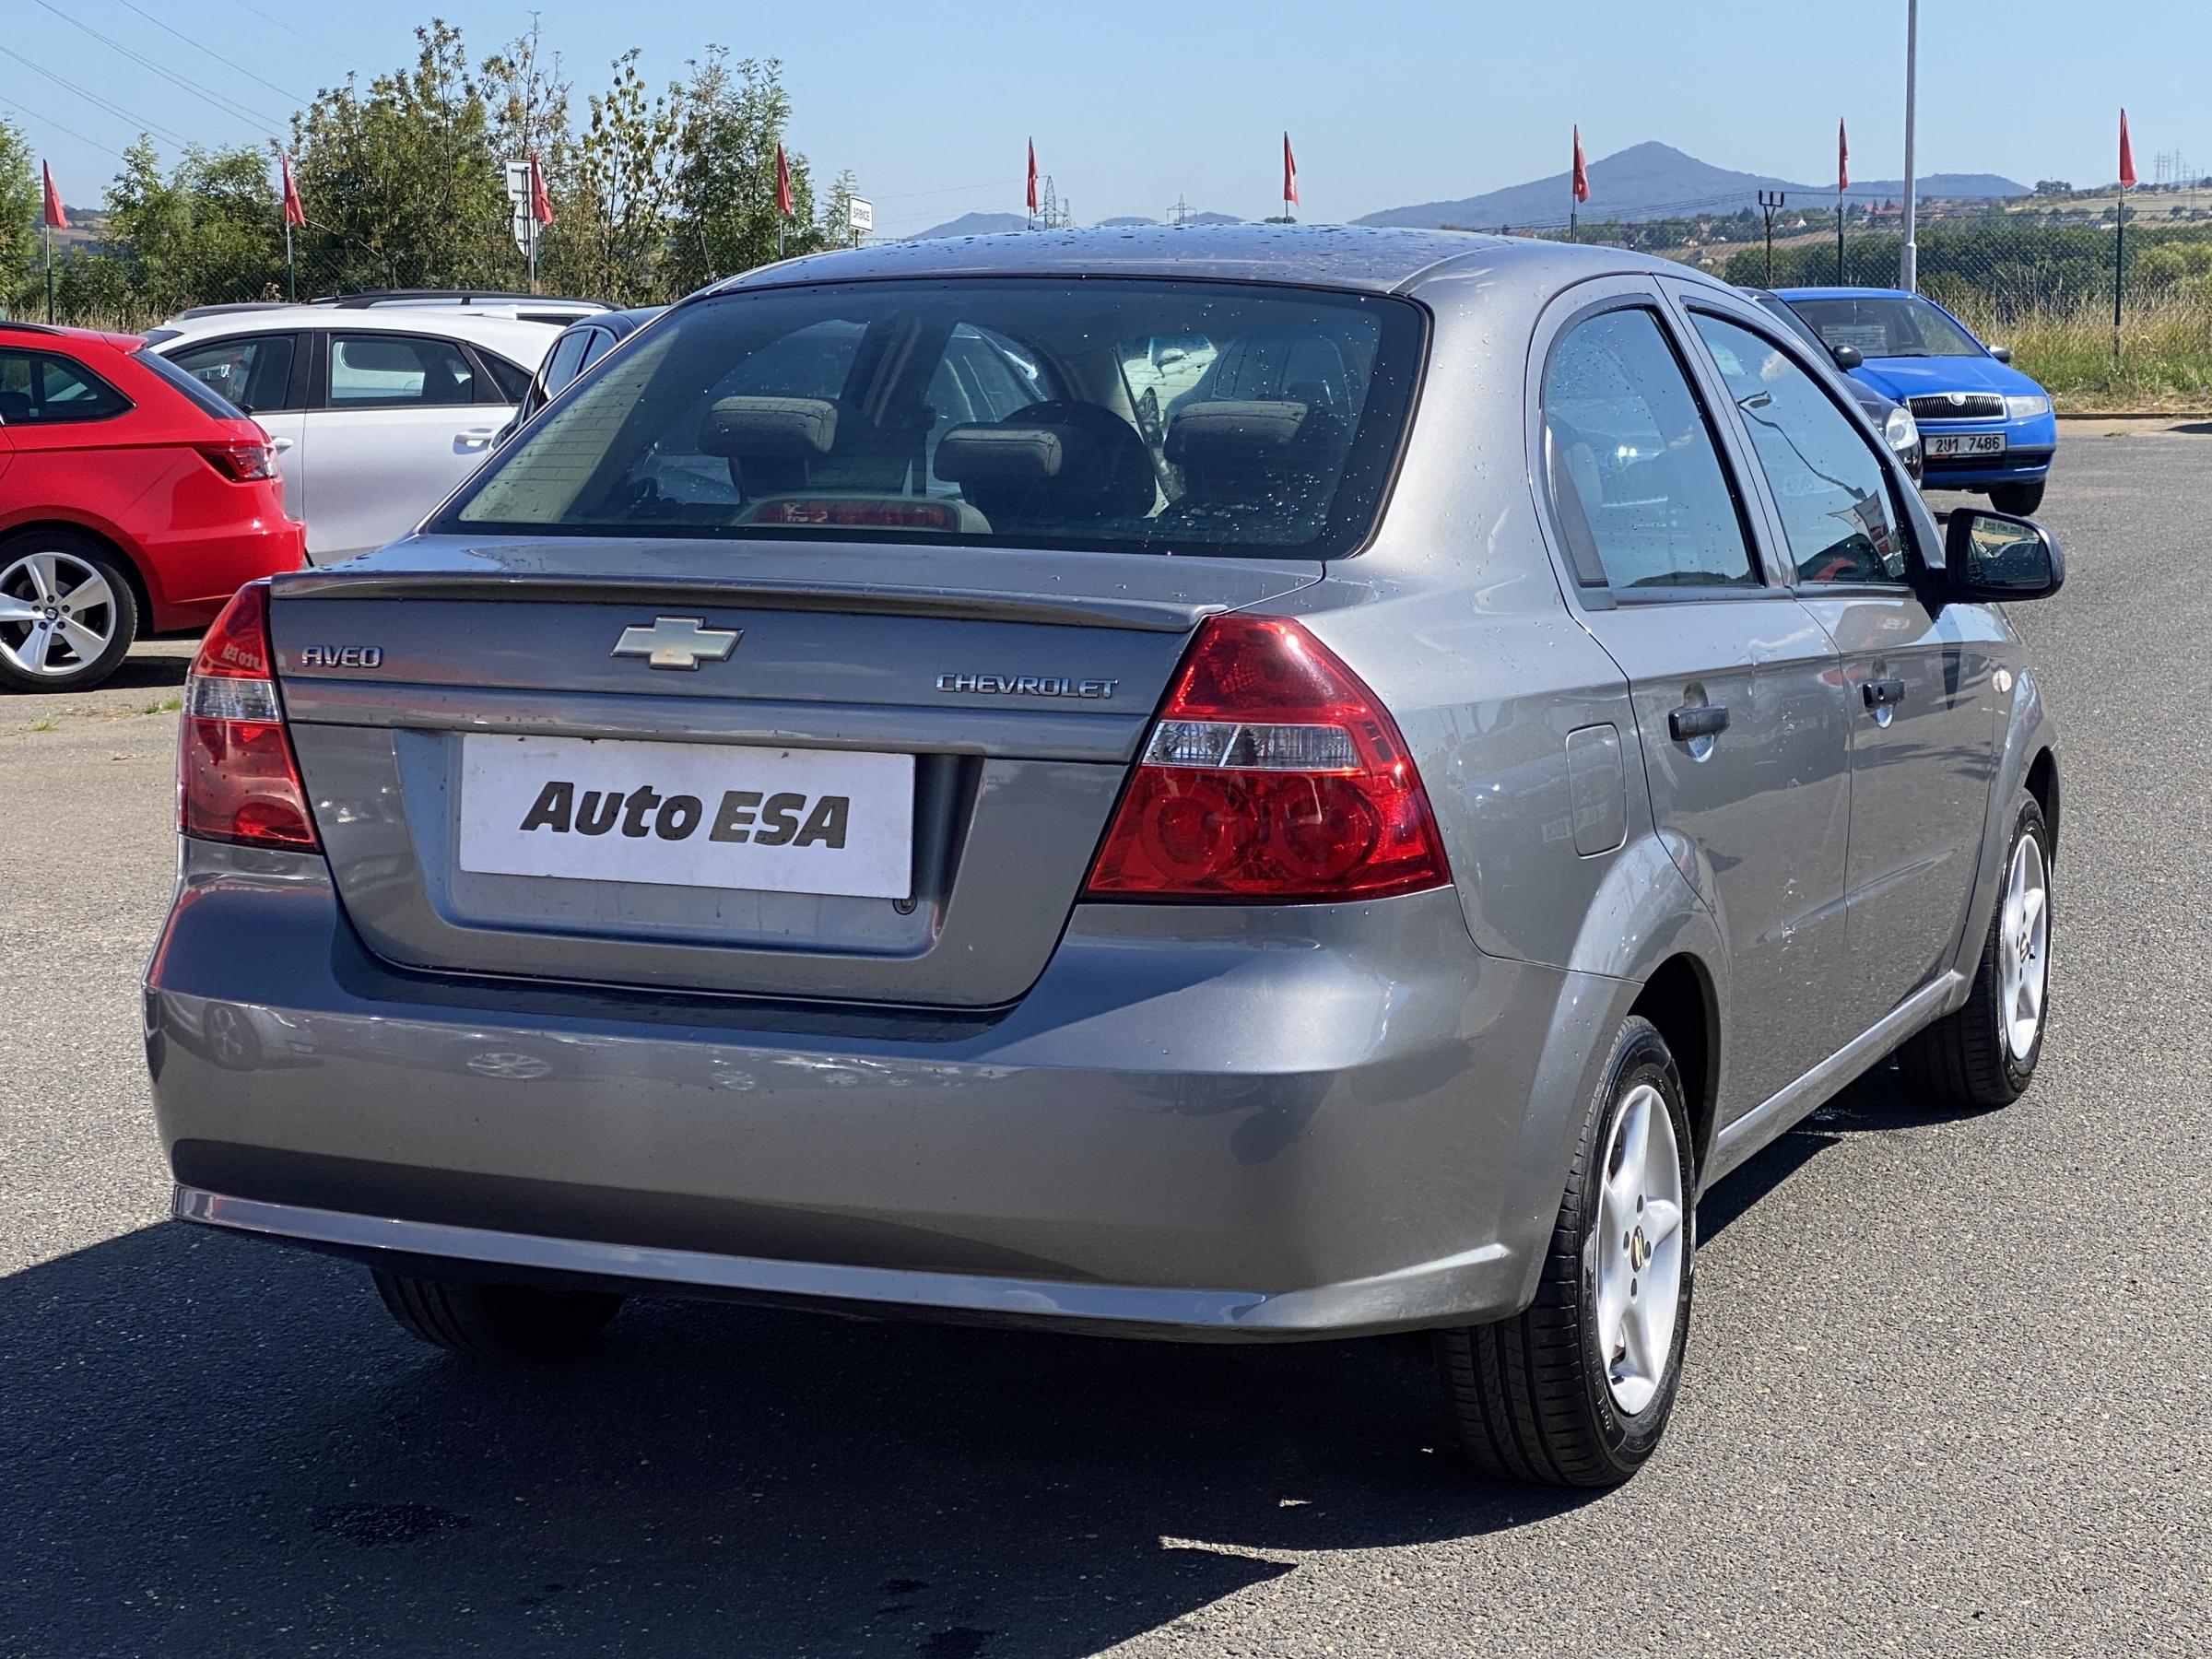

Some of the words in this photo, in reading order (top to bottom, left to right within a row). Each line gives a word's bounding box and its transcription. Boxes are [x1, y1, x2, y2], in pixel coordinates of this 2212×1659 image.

[1936, 438, 1959, 453] 2U1
[1969, 437, 2000, 452] 7486
[301, 645, 382, 667] AVEO
[935, 673, 1119, 699] CHEVROLET
[519, 781, 702, 841] Auto
[709, 790, 850, 849] ESA
